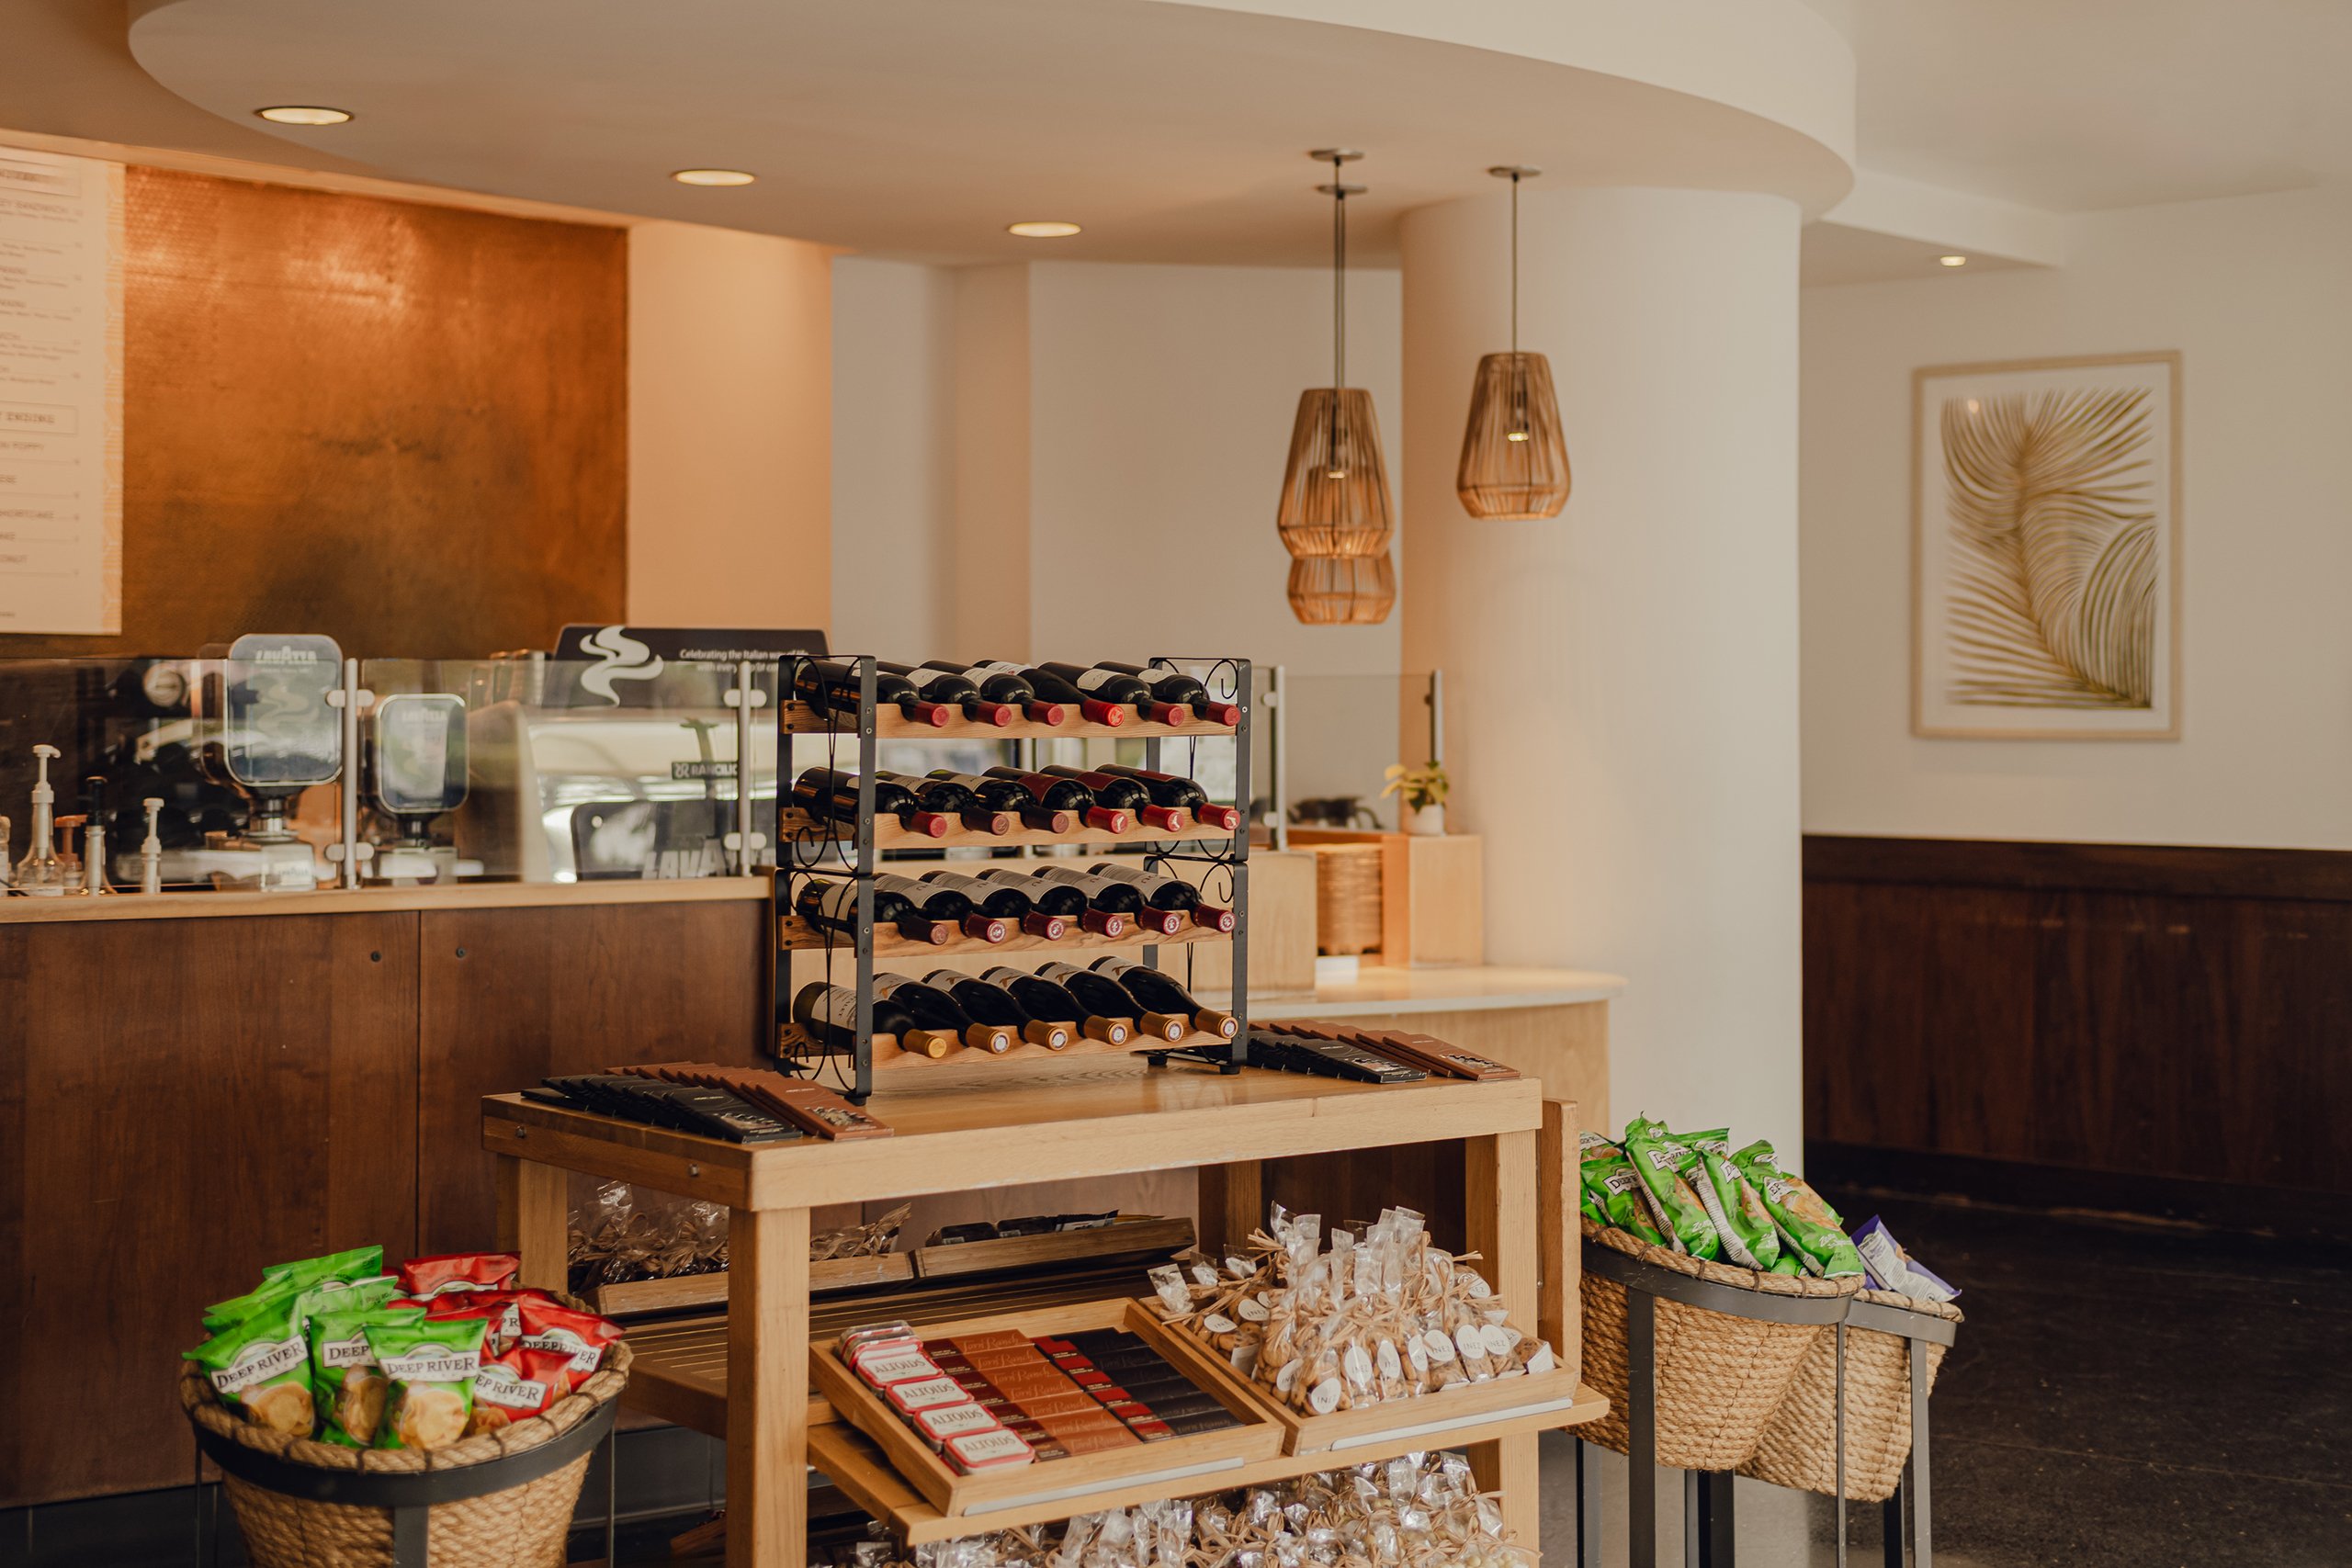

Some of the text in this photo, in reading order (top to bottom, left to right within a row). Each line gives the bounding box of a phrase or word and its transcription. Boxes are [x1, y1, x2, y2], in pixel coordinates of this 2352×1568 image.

[679, 649, 728, 661] Celebrating
[729, 650, 742, 660] the
[742, 650, 768, 660] Italian
[329, 1346, 368, 1361] DEEP
[216, 1340, 305, 1389] DEEP RIVER
[387, 1357, 476, 1376] DEEP RIVER
[875, 1358, 926, 1374] ALTOIDS
[492, 1382, 540, 1402] RIVER
[904, 1382, 956, 1399] ALTOIDS
[932, 1406, 983, 1426] ALTOIDS
[964, 1435, 1016, 1453] ALTOIDS
